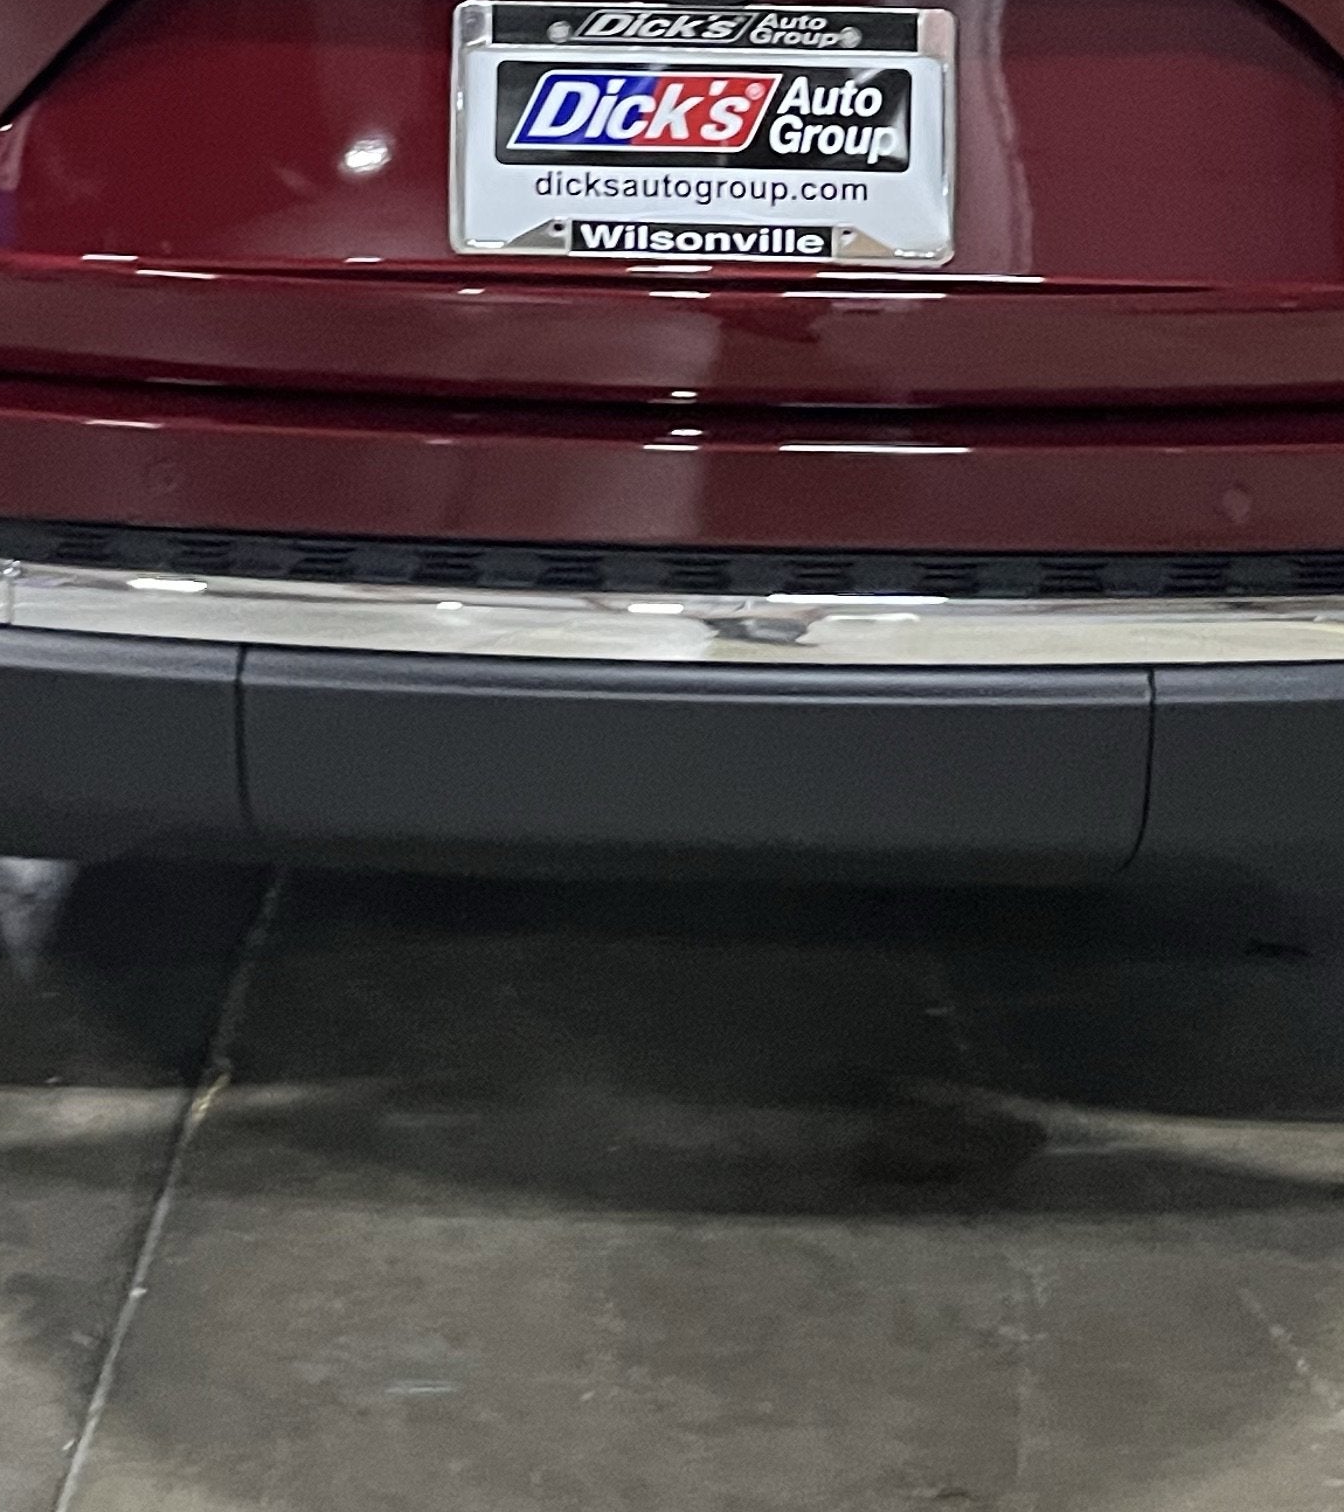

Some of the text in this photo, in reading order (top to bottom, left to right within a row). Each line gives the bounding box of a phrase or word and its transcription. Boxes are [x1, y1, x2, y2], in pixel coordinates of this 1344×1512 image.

[586, 11, 740, 39] Dick's
[760, 12, 828, 31] Auto
[750, 28, 838, 49] Group
[526, 79, 749, 143] Dick's
[776, 76, 883, 118] Auto
[769, 116, 901, 165] Group
[534, 172, 869, 207] dicksautogroup.com
[579, 224, 825, 256] Wilsonville
